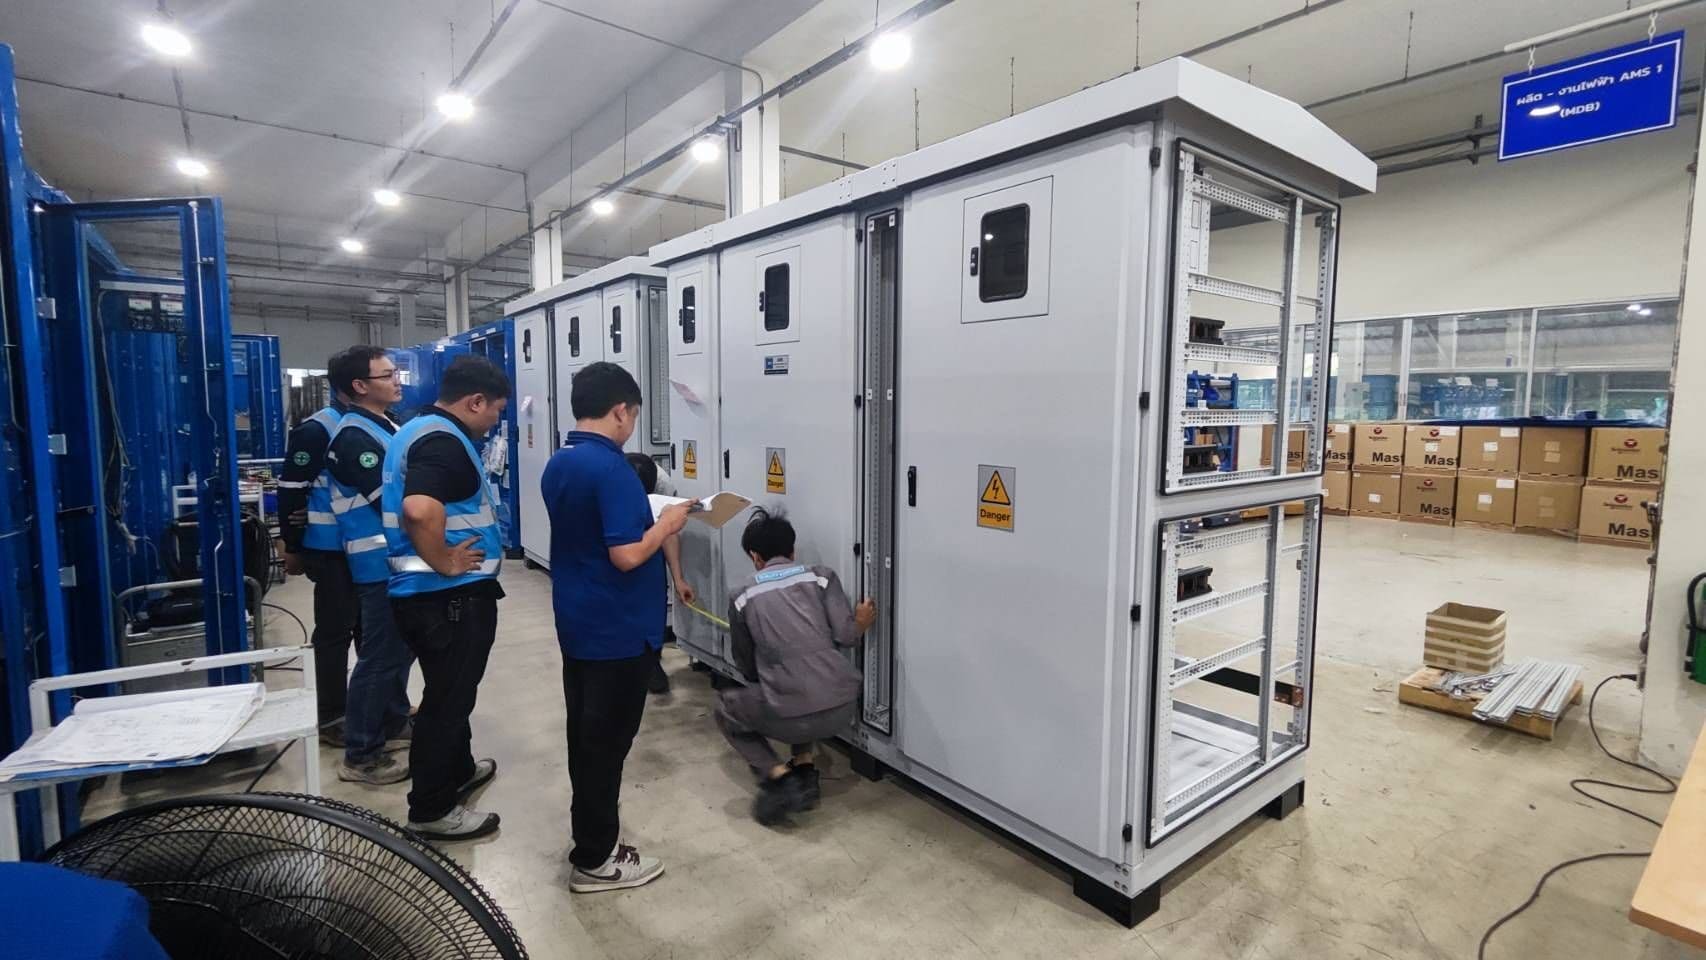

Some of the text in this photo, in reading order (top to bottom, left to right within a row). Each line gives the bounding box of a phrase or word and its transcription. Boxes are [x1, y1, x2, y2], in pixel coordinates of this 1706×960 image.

[1619, 67, 1651, 82] AMS
[1656, 64, 1663, 74] 1
[1560, 103, 1601, 118] (MDB)
[980, 509, 1011, 522] Danger
